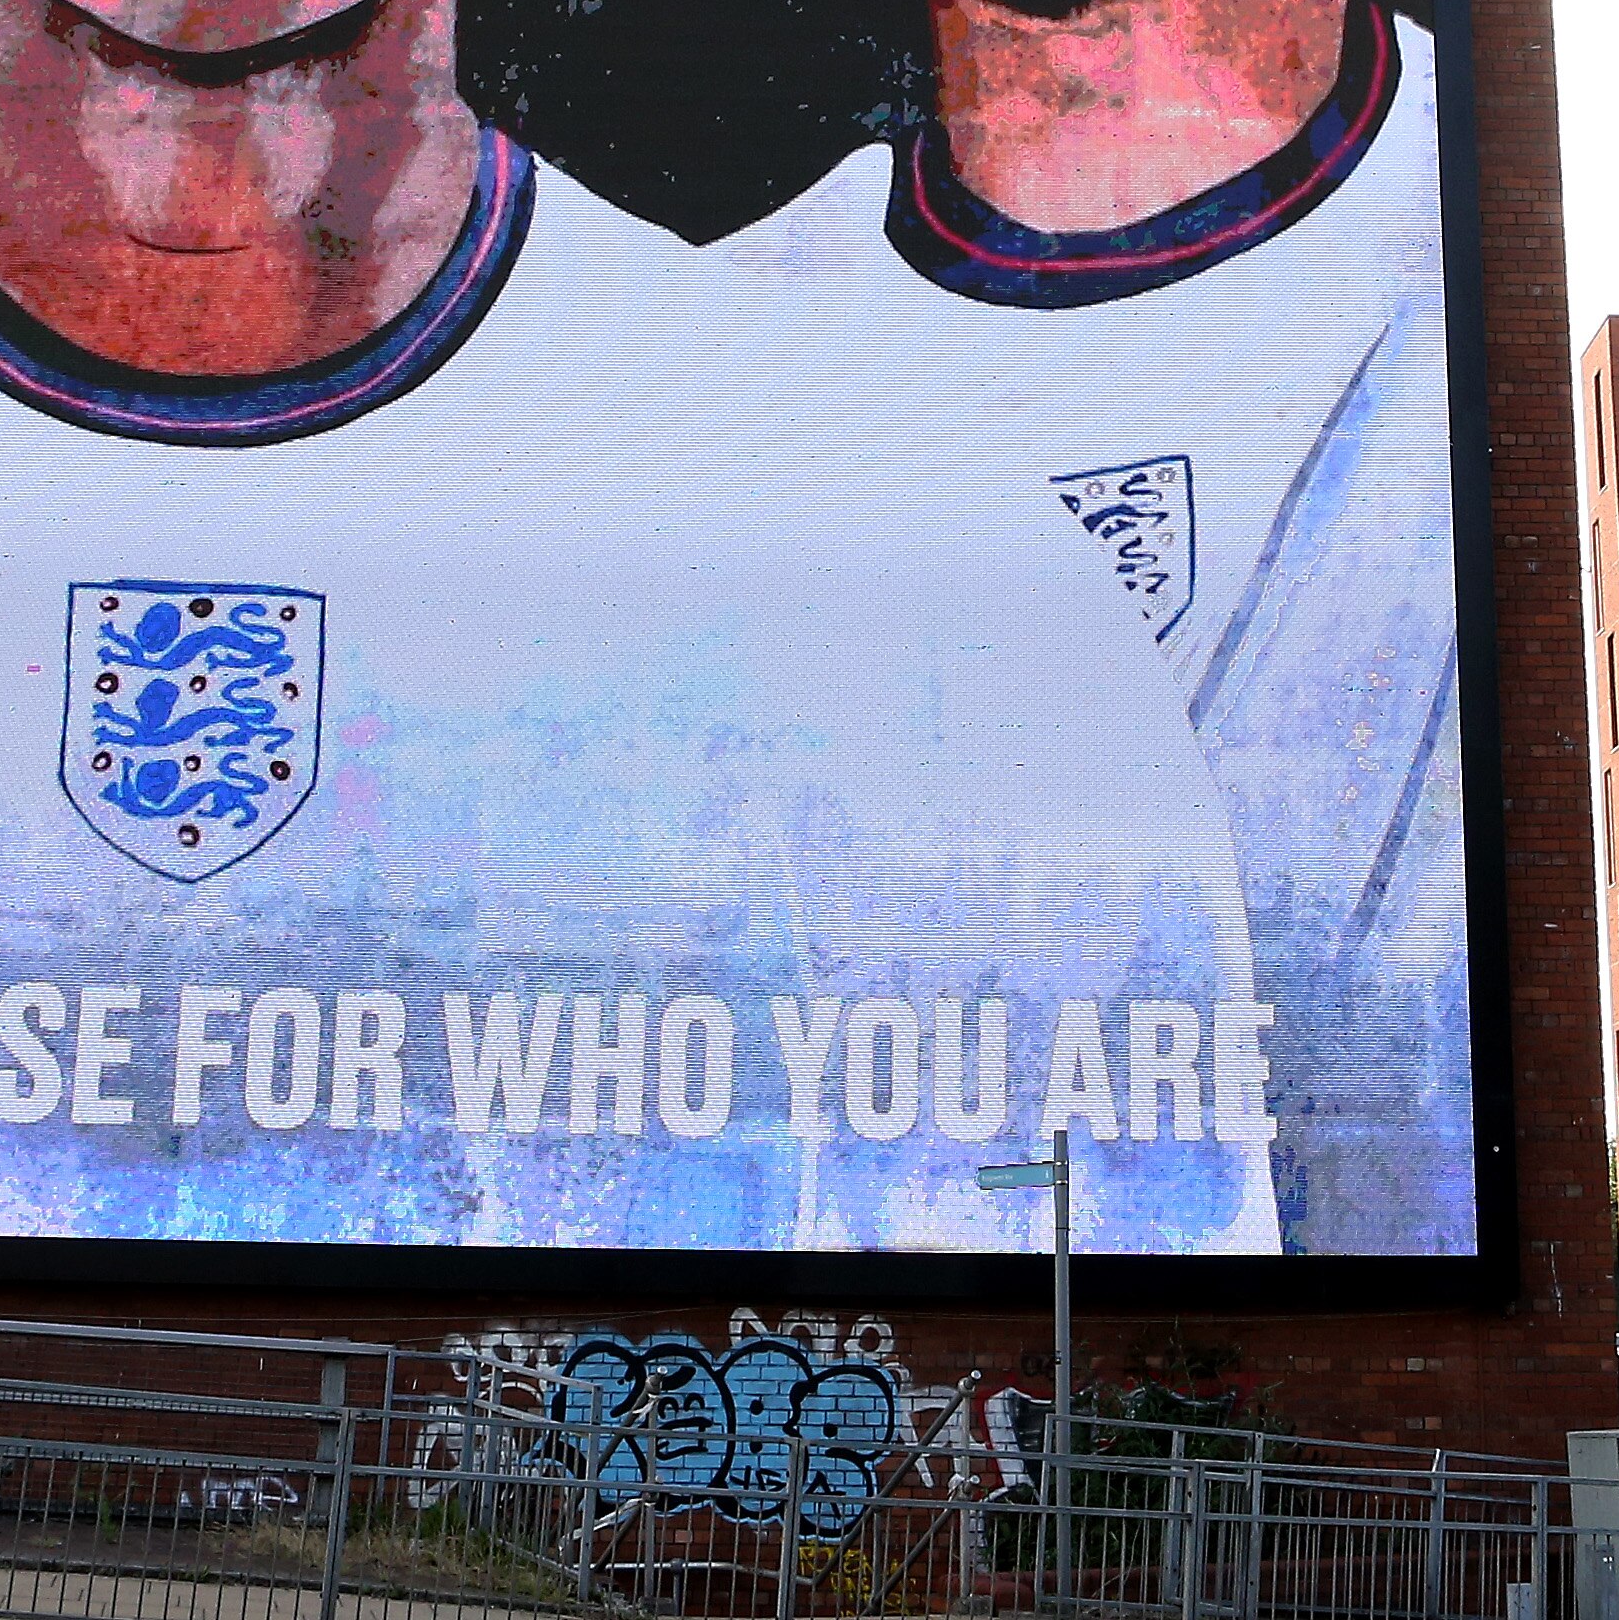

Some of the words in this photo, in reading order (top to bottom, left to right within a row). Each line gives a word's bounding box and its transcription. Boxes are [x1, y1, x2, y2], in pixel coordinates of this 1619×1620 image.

[173, 985, 407, 1131] FOR
[442, 990, 736, 1139] WHO
[771, 995, 1010, 1143] YOU
[1040, 998, 1279, 1143] ARE
